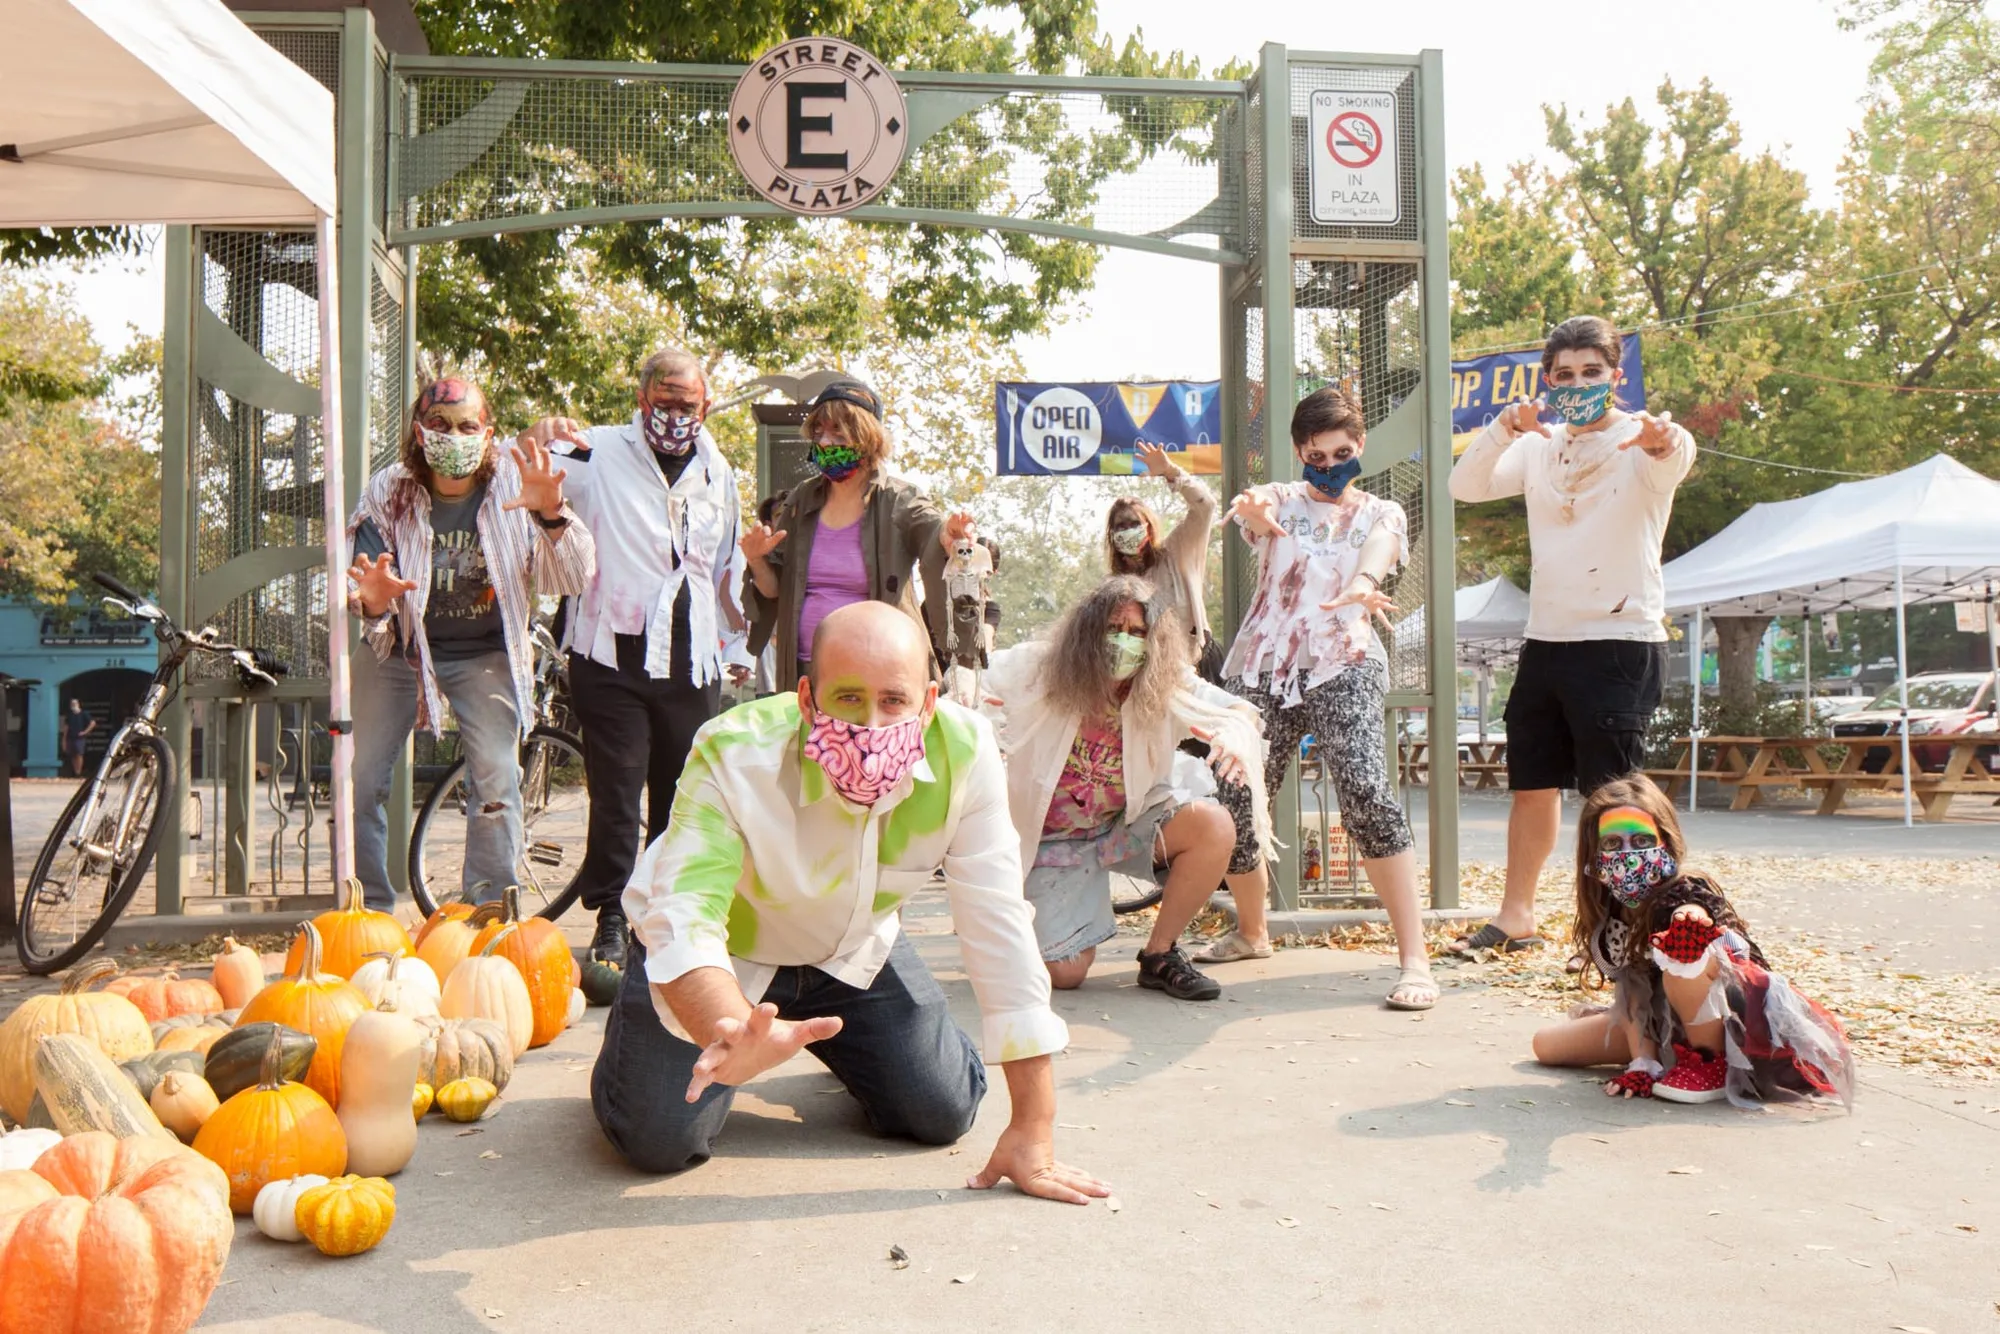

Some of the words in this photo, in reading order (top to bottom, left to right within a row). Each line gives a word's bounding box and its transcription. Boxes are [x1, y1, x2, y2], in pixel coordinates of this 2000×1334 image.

[759, 44, 881, 82] STREET
[1315, 96, 1332, 107] NO
[1338, 96, 1391, 109] SMOKING
[783, 79, 849, 173] E
[767, 175, 875, 208] PLAZA
[1348, 173, 1363, 186] IN
[1331, 190, 1380, 204] PLAZA
[1491, 362, 1547, 405] EAT.
[1032, 405, 1090, 430] OPEN
[1562, 404, 1601, 422] Party
[1043, 434, 1081, 459] AIR
